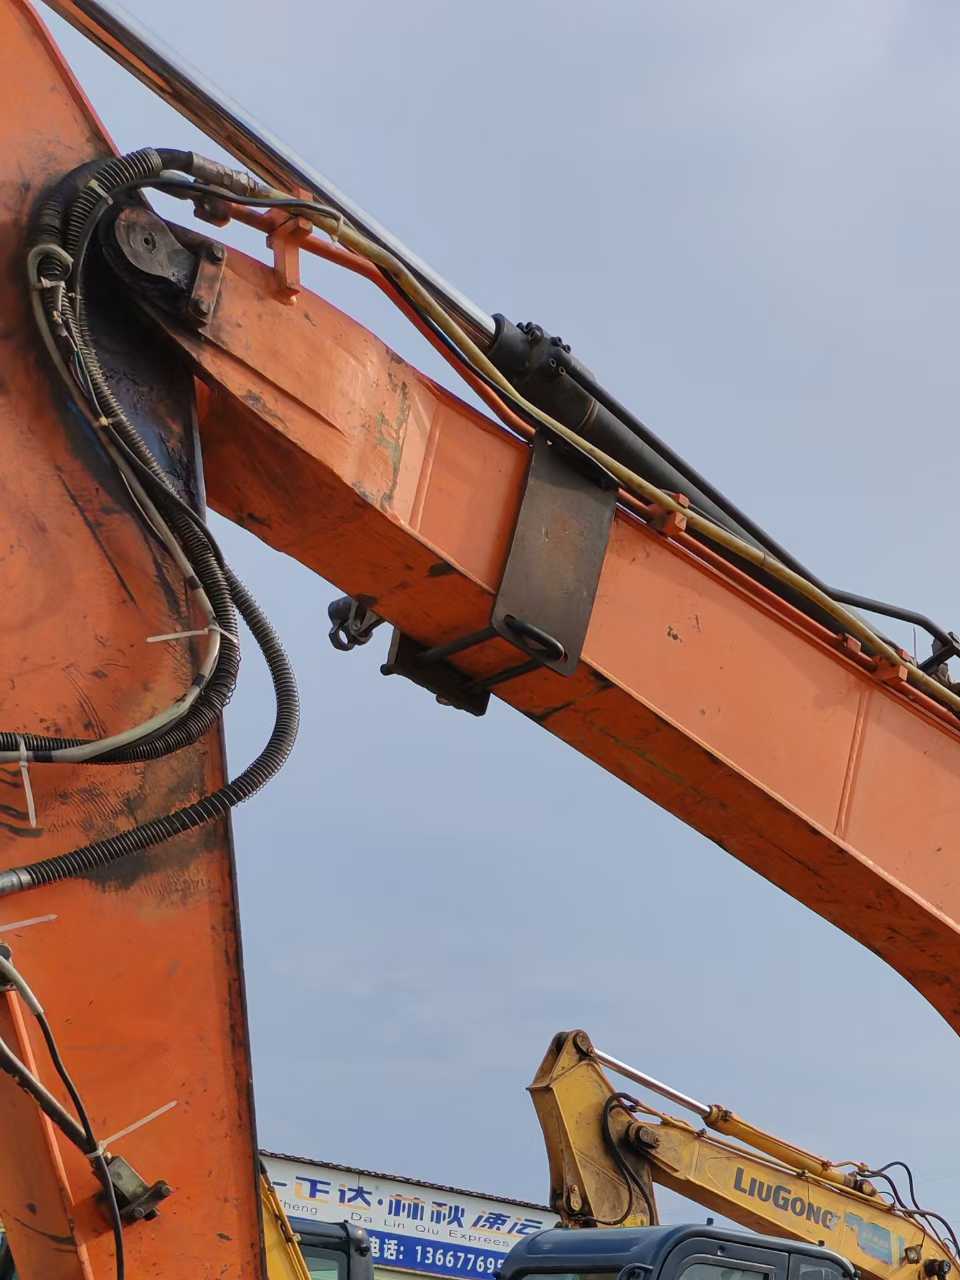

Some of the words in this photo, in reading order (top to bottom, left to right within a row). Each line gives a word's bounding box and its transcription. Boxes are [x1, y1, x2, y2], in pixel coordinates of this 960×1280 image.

[280, 1199, 318, 1215] heng
[351, 1212, 372, 1223] Da
[384, 1216, 405, 1229] Lin
[416, 1224, 439, 1235] Qiu
